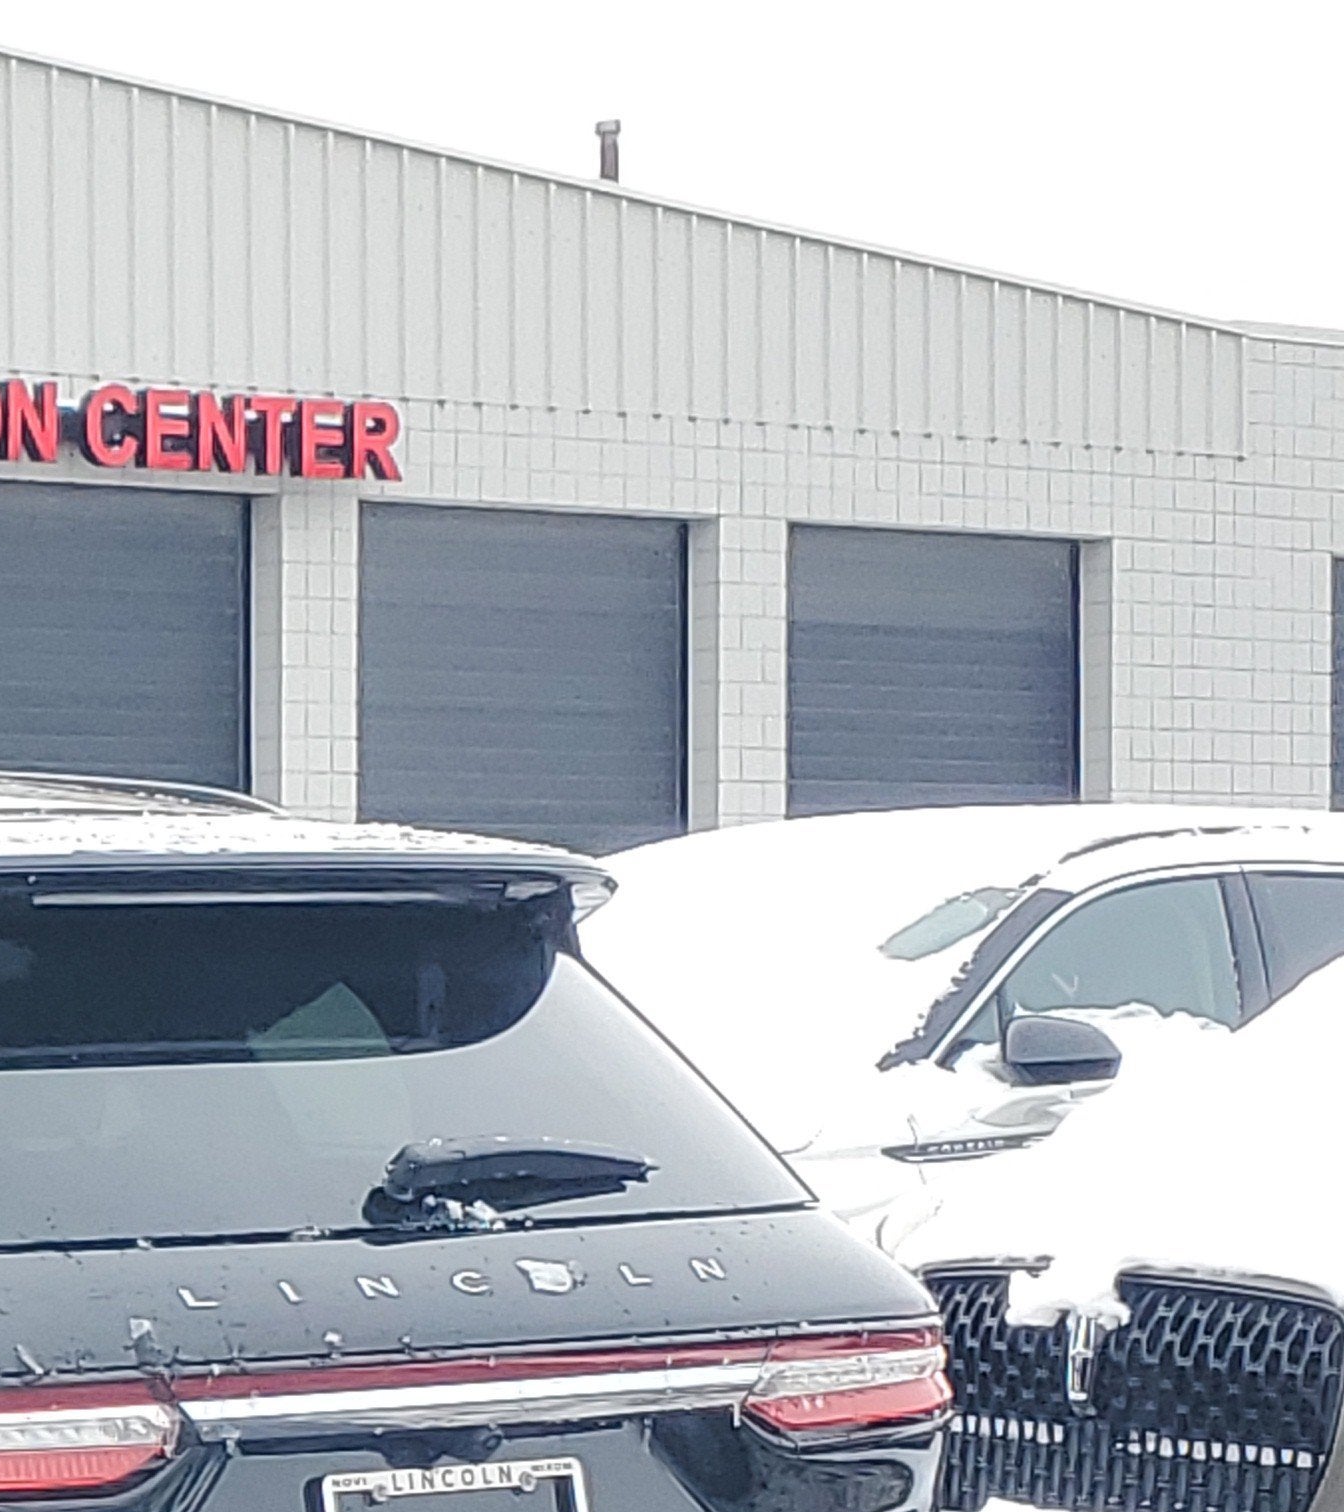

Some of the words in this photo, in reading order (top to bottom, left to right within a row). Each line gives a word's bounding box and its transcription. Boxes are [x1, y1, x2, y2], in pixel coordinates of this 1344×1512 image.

[85, 383, 403, 482] CENTER
[177, 1257, 727, 1308] LINCLN
[391, 1465, 512, 1492] LINCOLN
